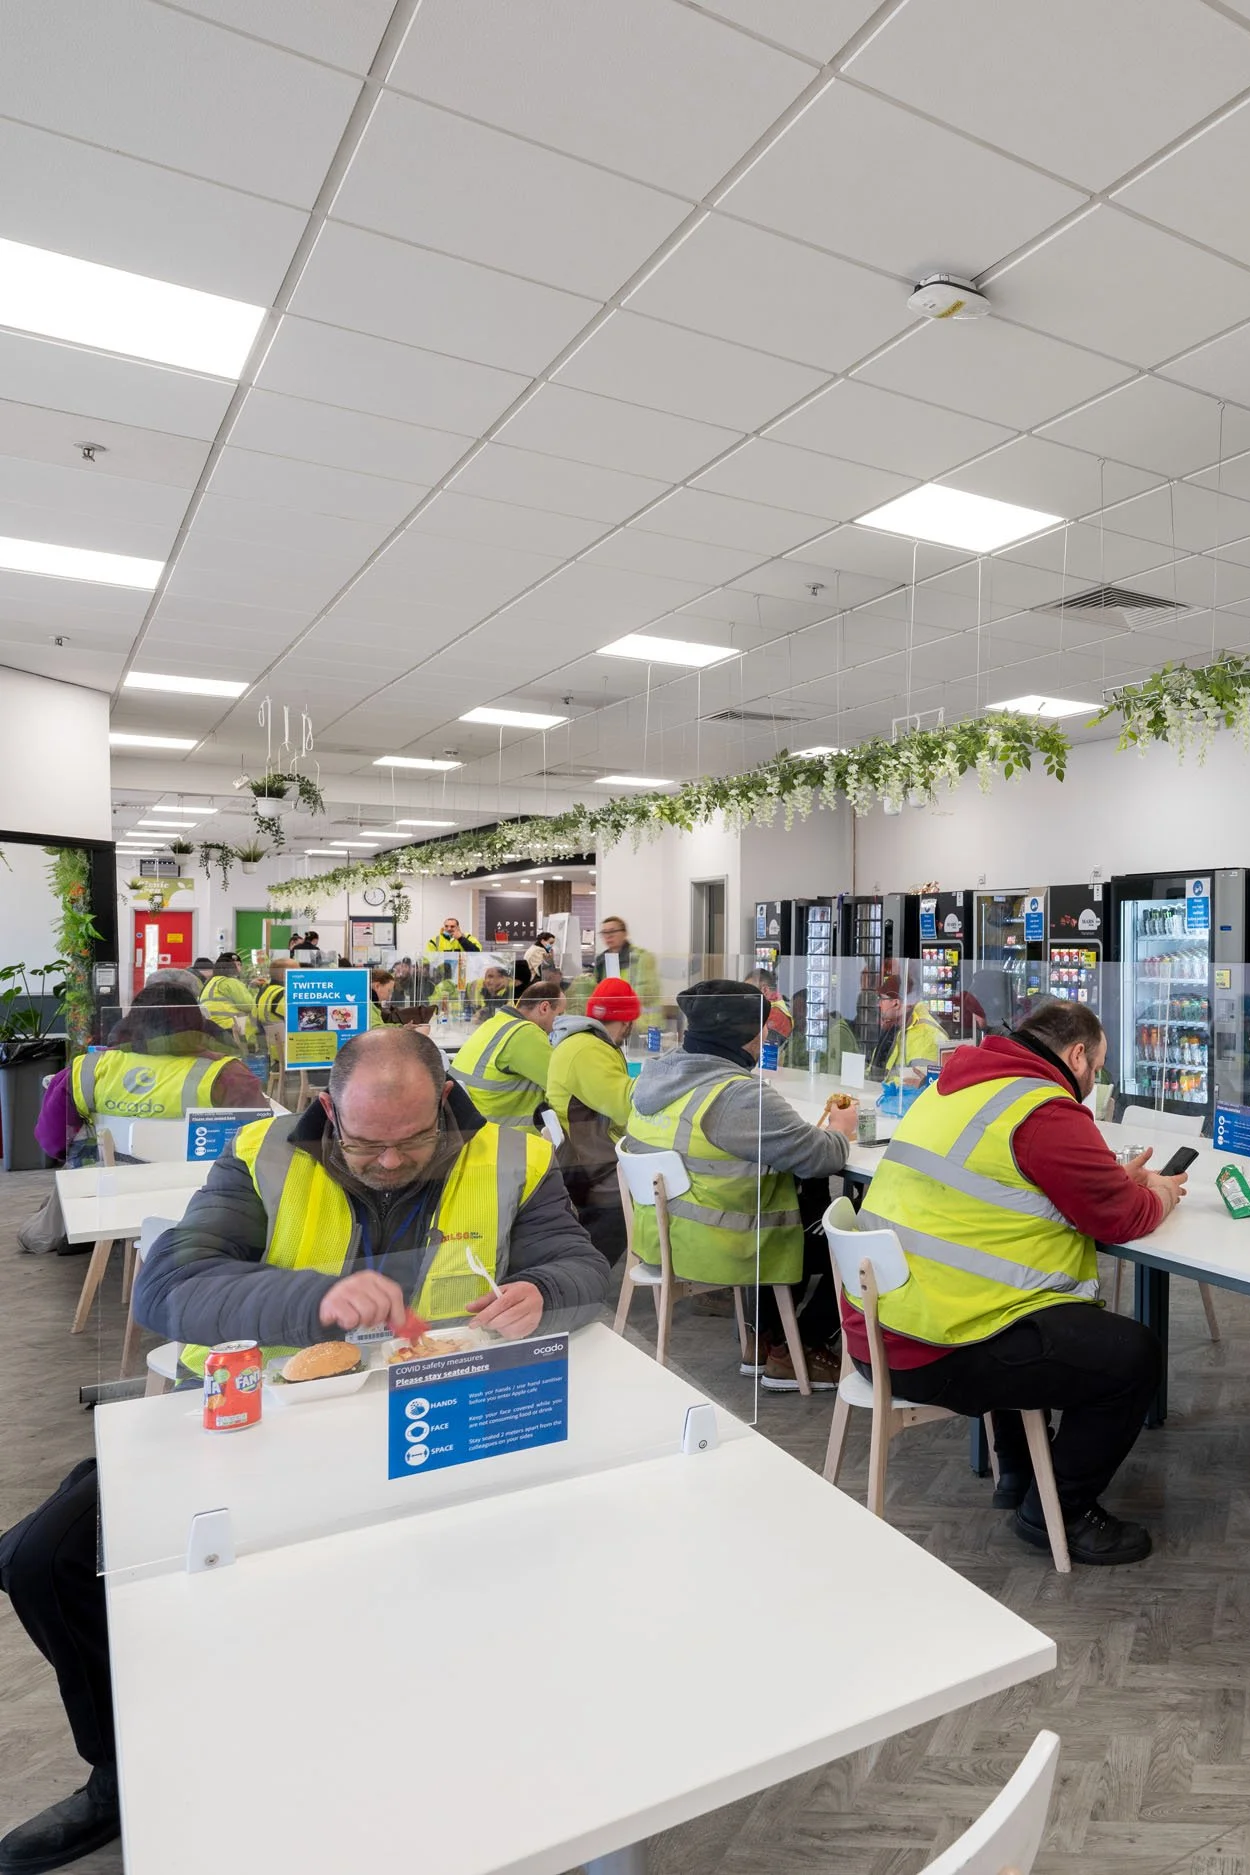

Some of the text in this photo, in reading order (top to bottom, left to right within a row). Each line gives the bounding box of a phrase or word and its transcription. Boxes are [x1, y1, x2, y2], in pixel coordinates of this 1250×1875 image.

[293, 992, 341, 1000] FEEDBACK
[105, 1099, 165, 1114] ocado
[533, 1343, 564, 1355] ocado
[395, 1354, 484, 1375] COVID safety measures
[395, 1363, 490, 1387] Please stay seated here
[468, 1391, 483, 1399] Wash
[495, 1386, 511, 1394] hands
[468, 1397, 486, 1405] before
[511, 1389, 526, 1397] Apple
[430, 1398, 458, 1410] HANDS
[513, 1403, 534, 1412] covered
[489, 1414, 519, 1424] consuming
[430, 1422, 449, 1432] FACE
[482, 1433, 500, 1441] seated
[505, 1428, 524, 1436] meters
[525, 1424, 539, 1432] apart
[540, 1421, 552, 1429] from
[430, 1444, 454, 1455] SPACE
[468, 1441, 498, 1451] colleagues
[507, 1436, 519, 1444] your
